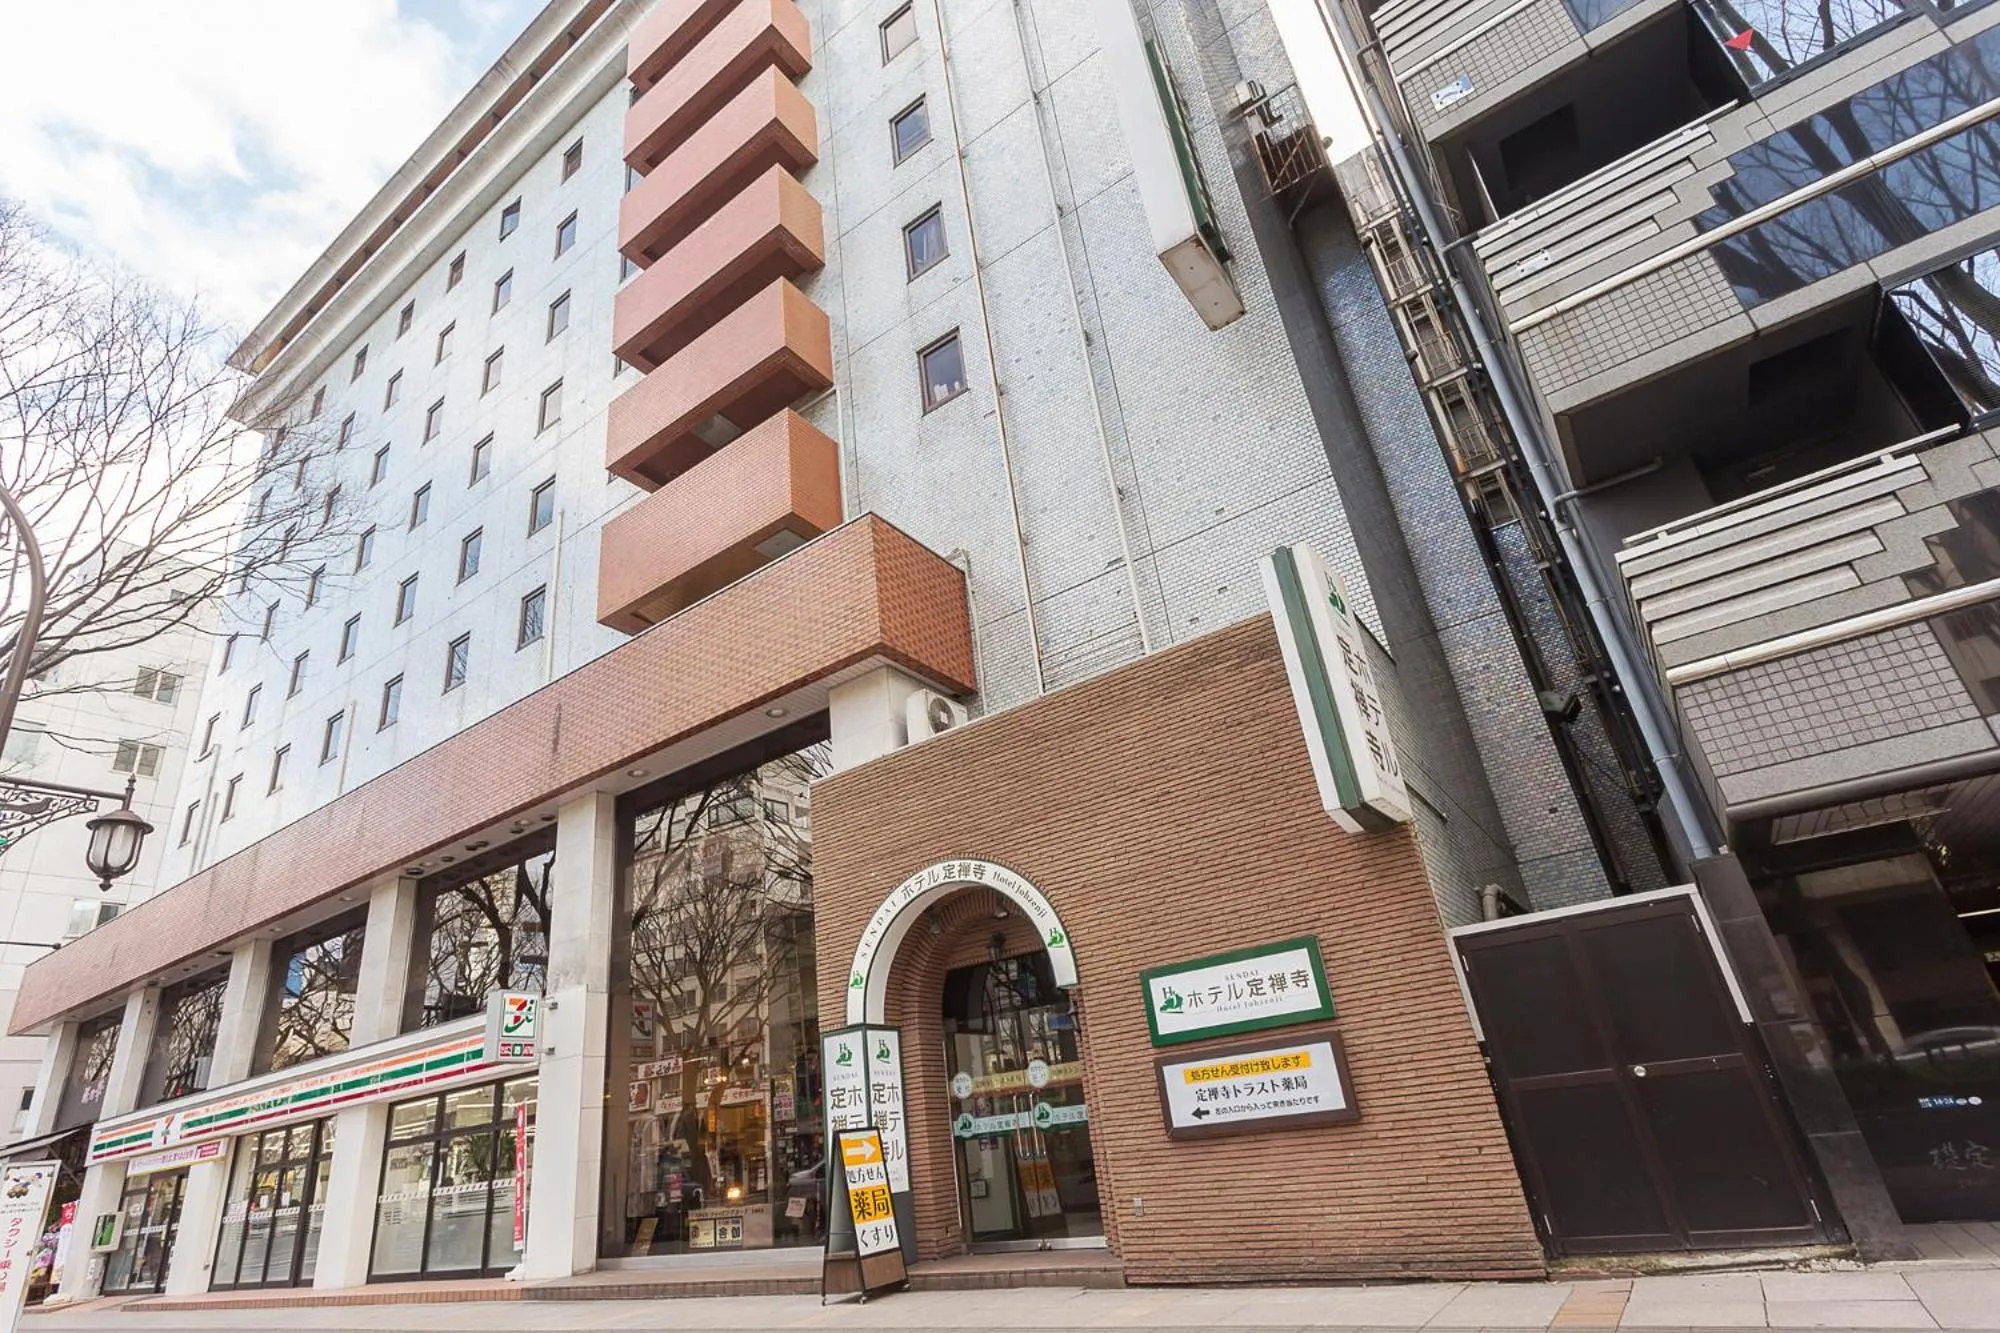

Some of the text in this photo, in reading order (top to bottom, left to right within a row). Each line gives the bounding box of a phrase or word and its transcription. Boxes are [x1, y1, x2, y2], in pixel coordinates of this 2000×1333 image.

[1336, 633, 1385, 772] 定禅寺
[1354, 651, 1398, 777] ホテル
[901, 862, 986, 900] ホテル定禅寺
[992, 871, 1048, 918] Hotel Johzenji
[861, 901, 896, 958] SENDAI
[1187, 969, 1310, 1008] ホテル定禅寺
[1225, 969, 1259, 981] SENDAI
[1217, 1003, 1240, 1012] Hotel
[1190, 1055, 1301, 1080] 処方せん受付け致します
[1195, 1075, 1308, 1102] 定禅寺トラスト薬局
[886, 1083, 904, 1161] ホテル
[846, 1166, 884, 1183] 処方せん
[853, 1188, 890, 1220] 薬局
[860, 1224, 894, 1248] くすり
